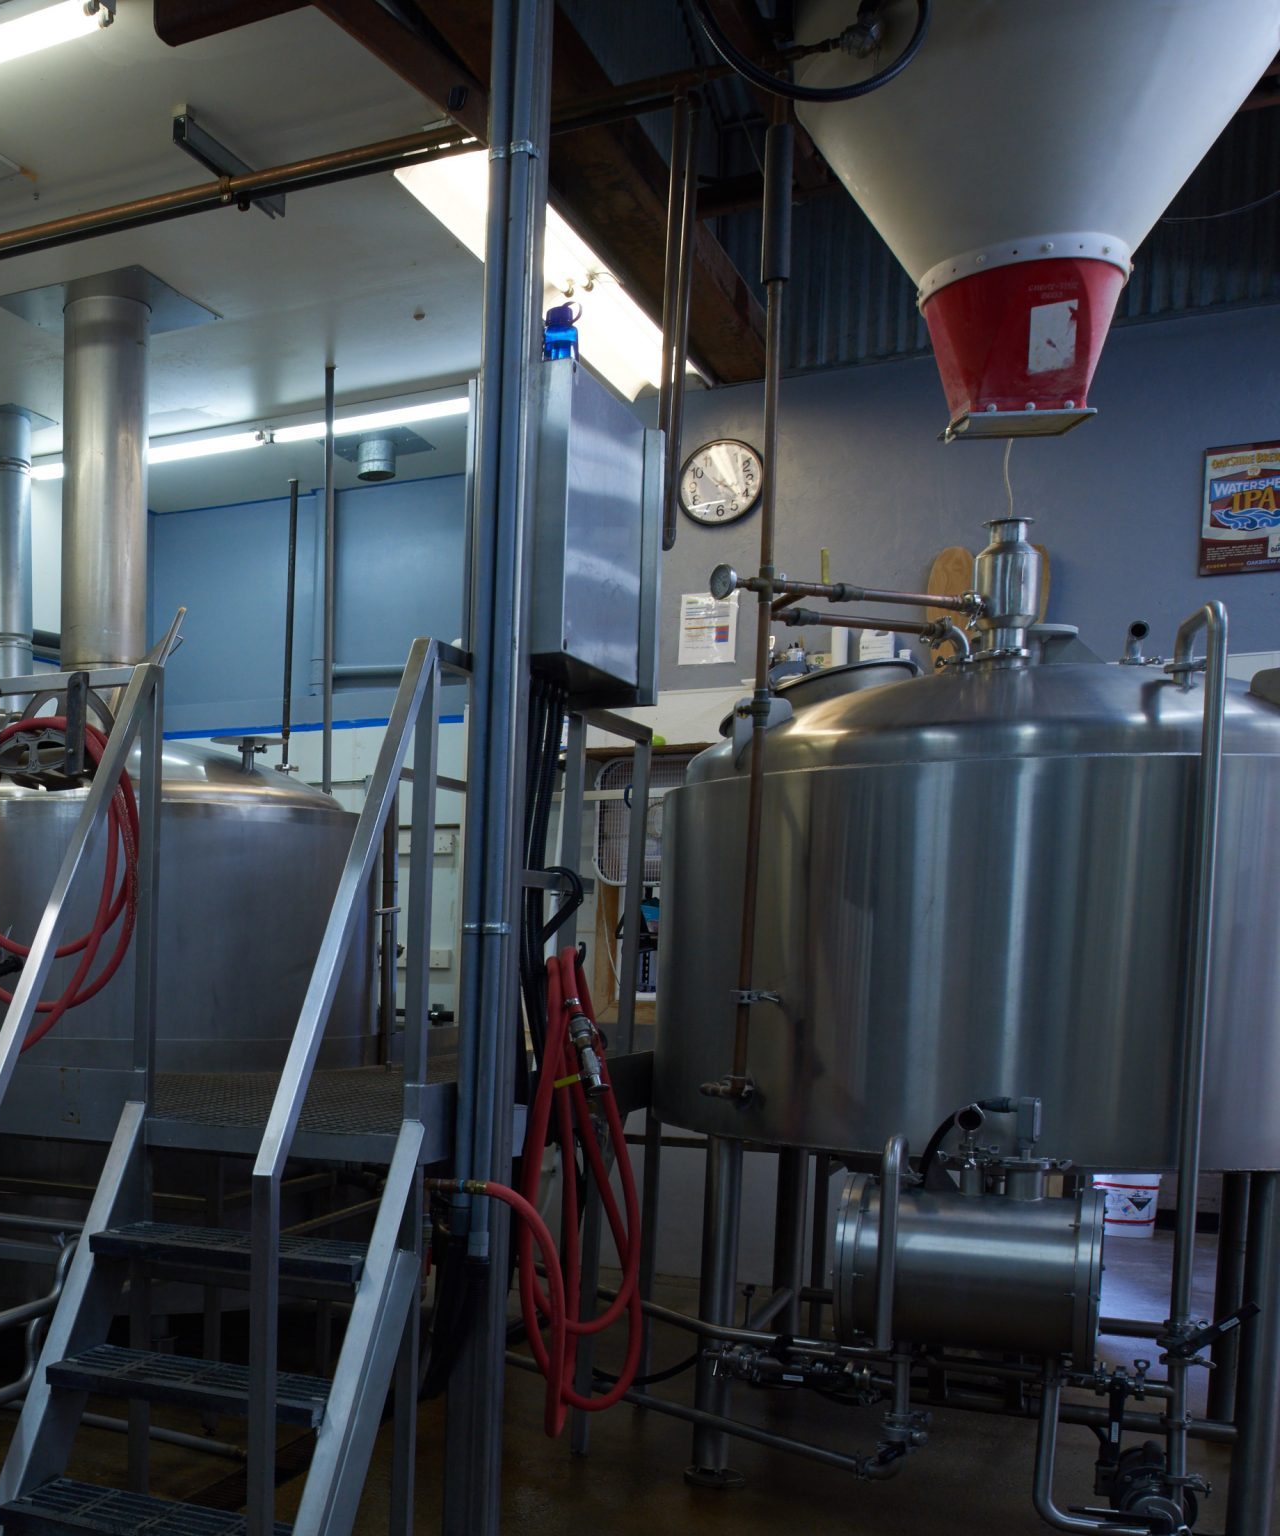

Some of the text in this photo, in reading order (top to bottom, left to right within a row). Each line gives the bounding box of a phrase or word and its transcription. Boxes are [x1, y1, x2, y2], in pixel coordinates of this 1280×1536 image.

[689, 466, 704, 479] 10
[688, 481, 697, 493] 9
[1213, 477, 1280, 498] WATERSHE
[730, 499, 739, 511] 5
[1232, 486, 1276, 513] IPA
[716, 505, 725, 516] 6
